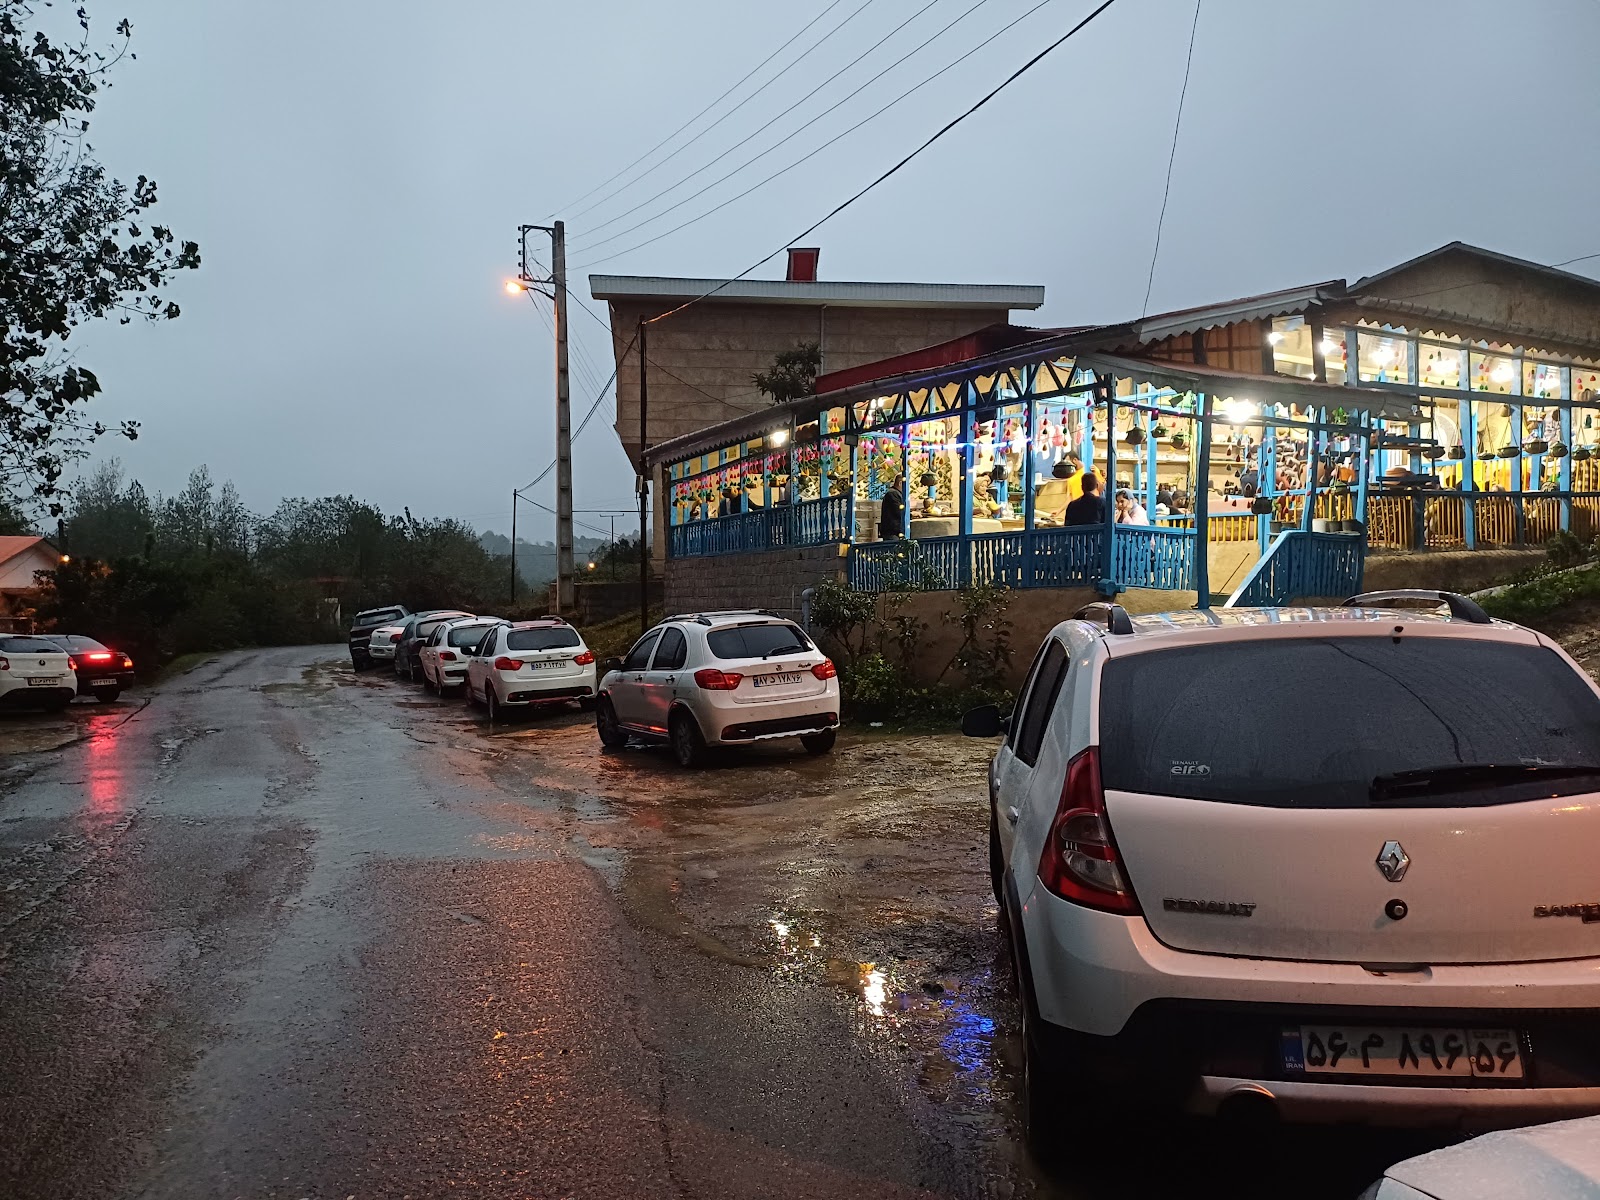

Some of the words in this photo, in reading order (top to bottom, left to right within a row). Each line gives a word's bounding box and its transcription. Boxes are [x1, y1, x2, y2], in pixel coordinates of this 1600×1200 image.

[1170, 765, 1196, 775] elf
[1306, 1030, 1348, 1068] ۵۶
[1398, 1031, 1464, 1071] ۸۹۶
[1475, 1040, 1517, 1073] ۵۶
